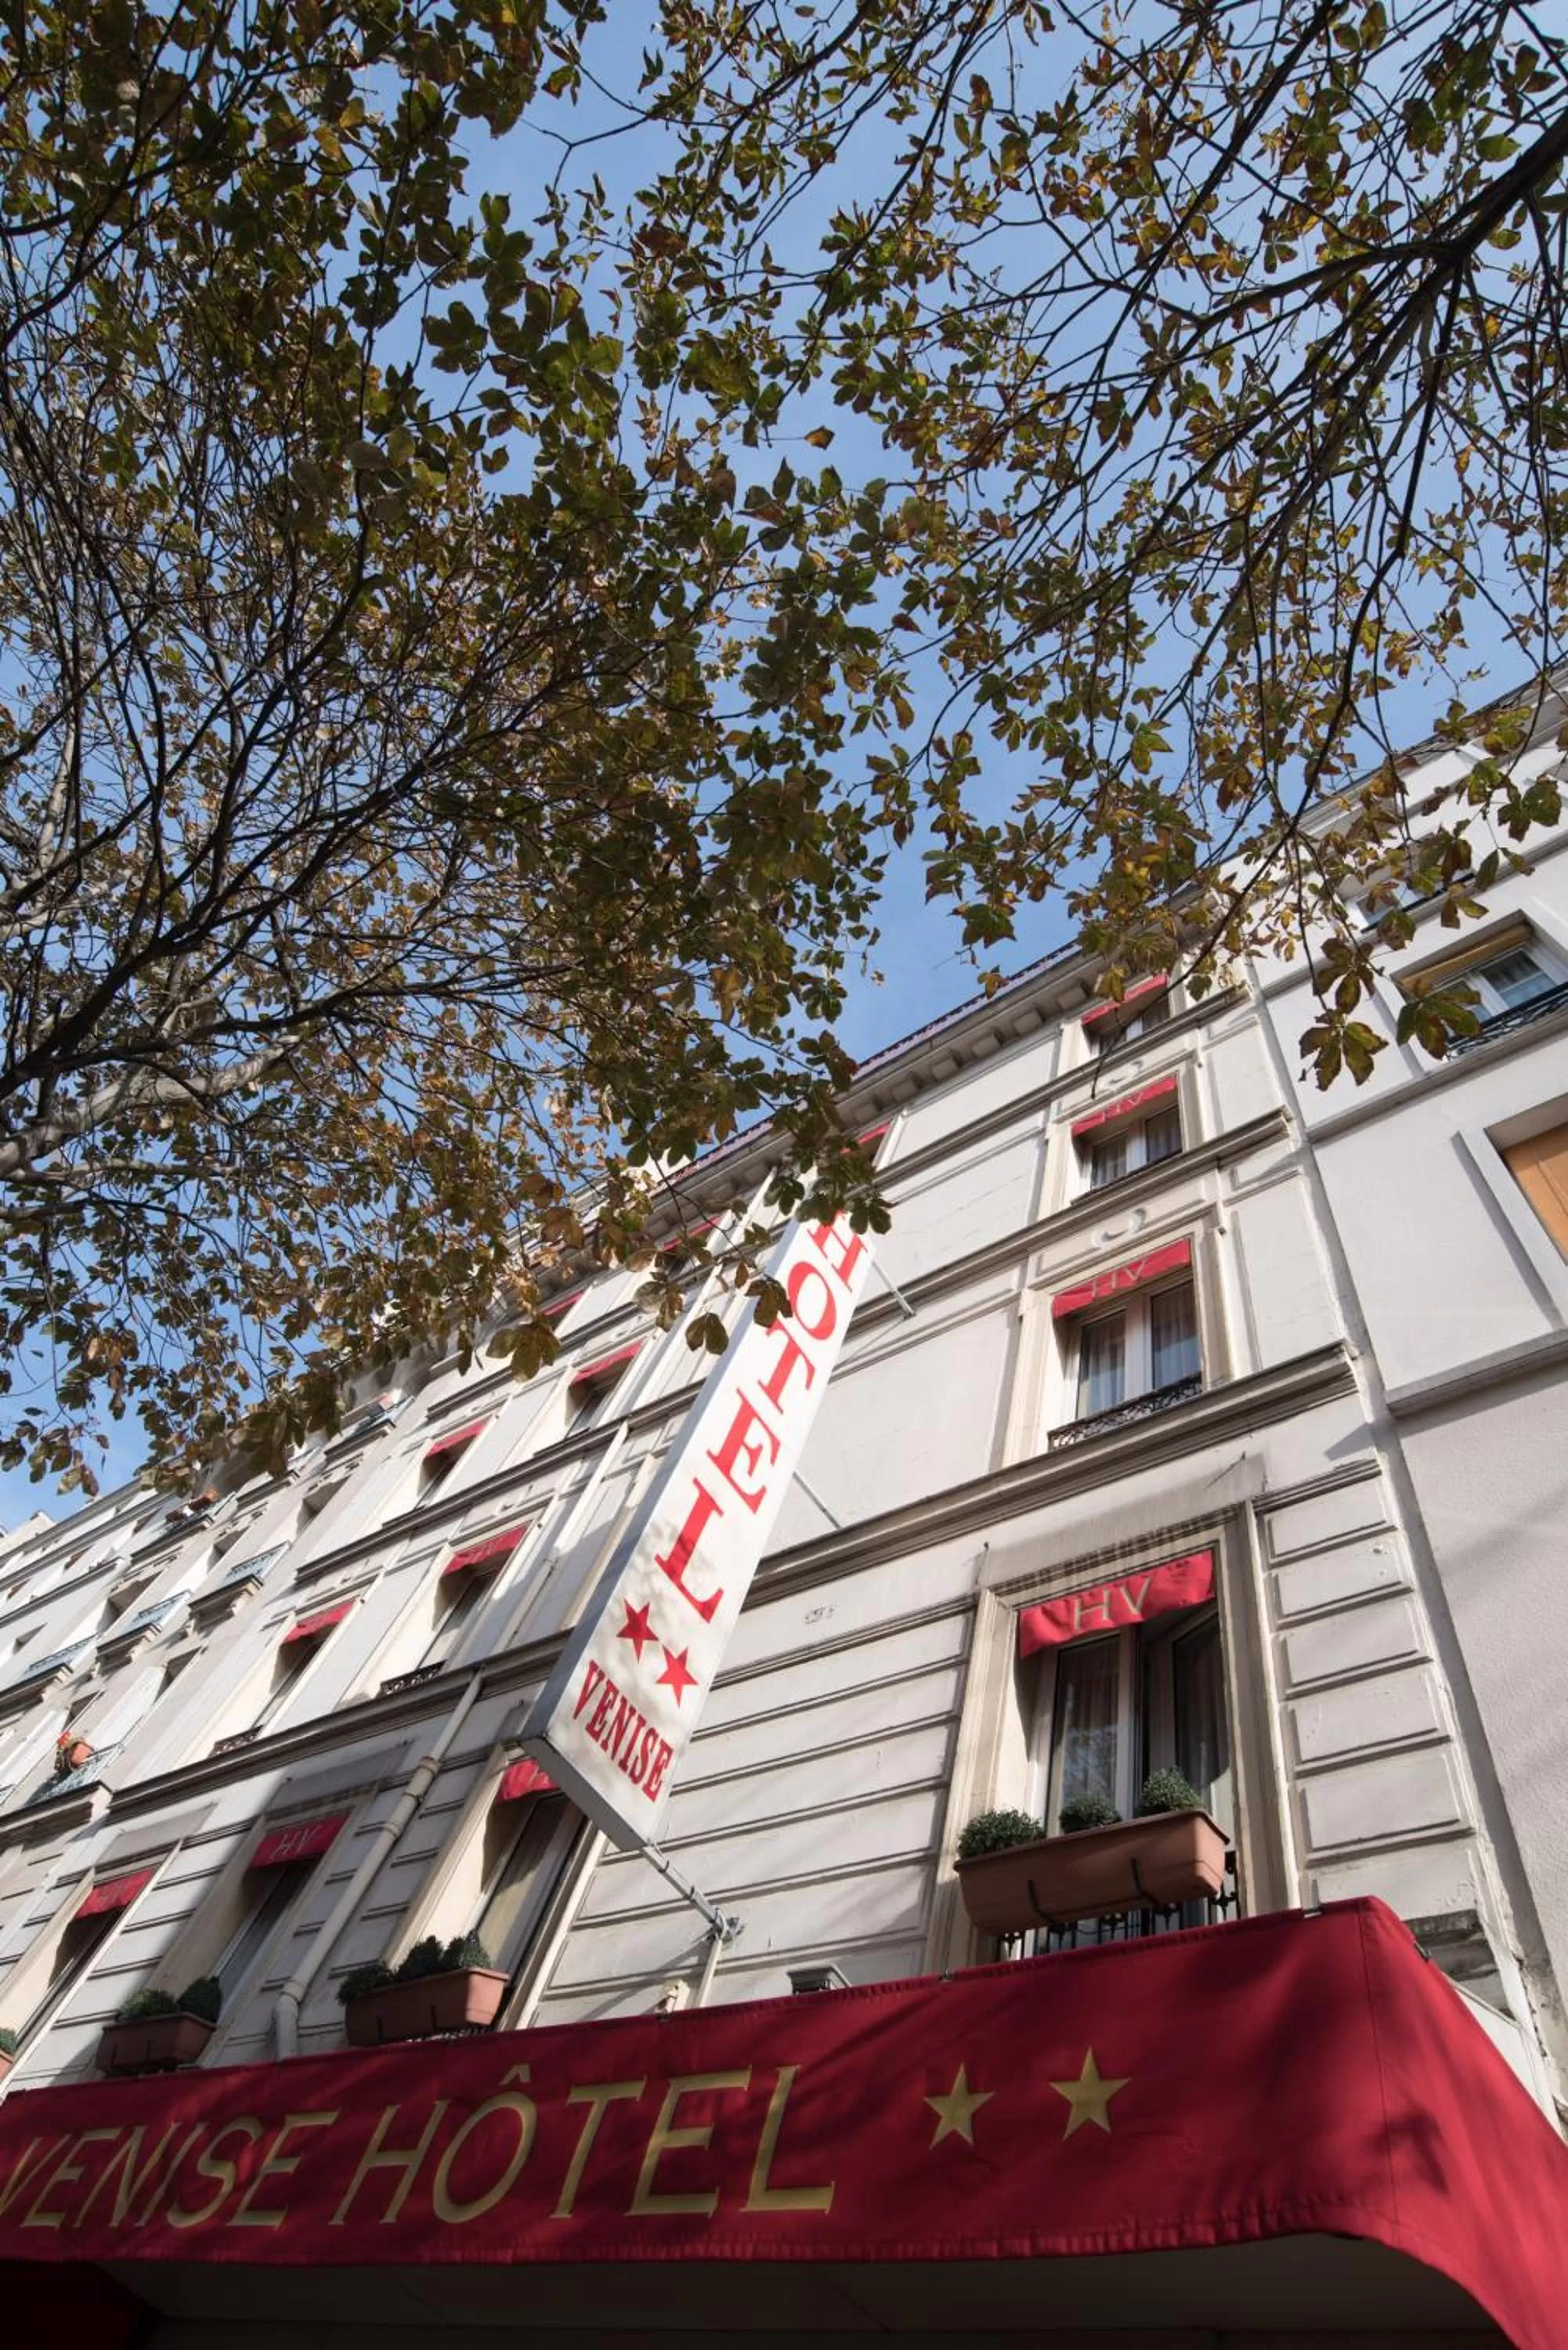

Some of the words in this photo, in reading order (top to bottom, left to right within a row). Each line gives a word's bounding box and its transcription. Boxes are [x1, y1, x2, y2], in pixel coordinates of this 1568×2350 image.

[1091, 1259, 1148, 1298] HV
[655, 1208, 869, 1625] HOTEL
[1074, 1574, 1154, 1631] HV
[573, 1658, 674, 1803] VENISE
[0, 2110, 338, 2231] VENISE
[328, 2062, 836, 2227] HÔTEL
